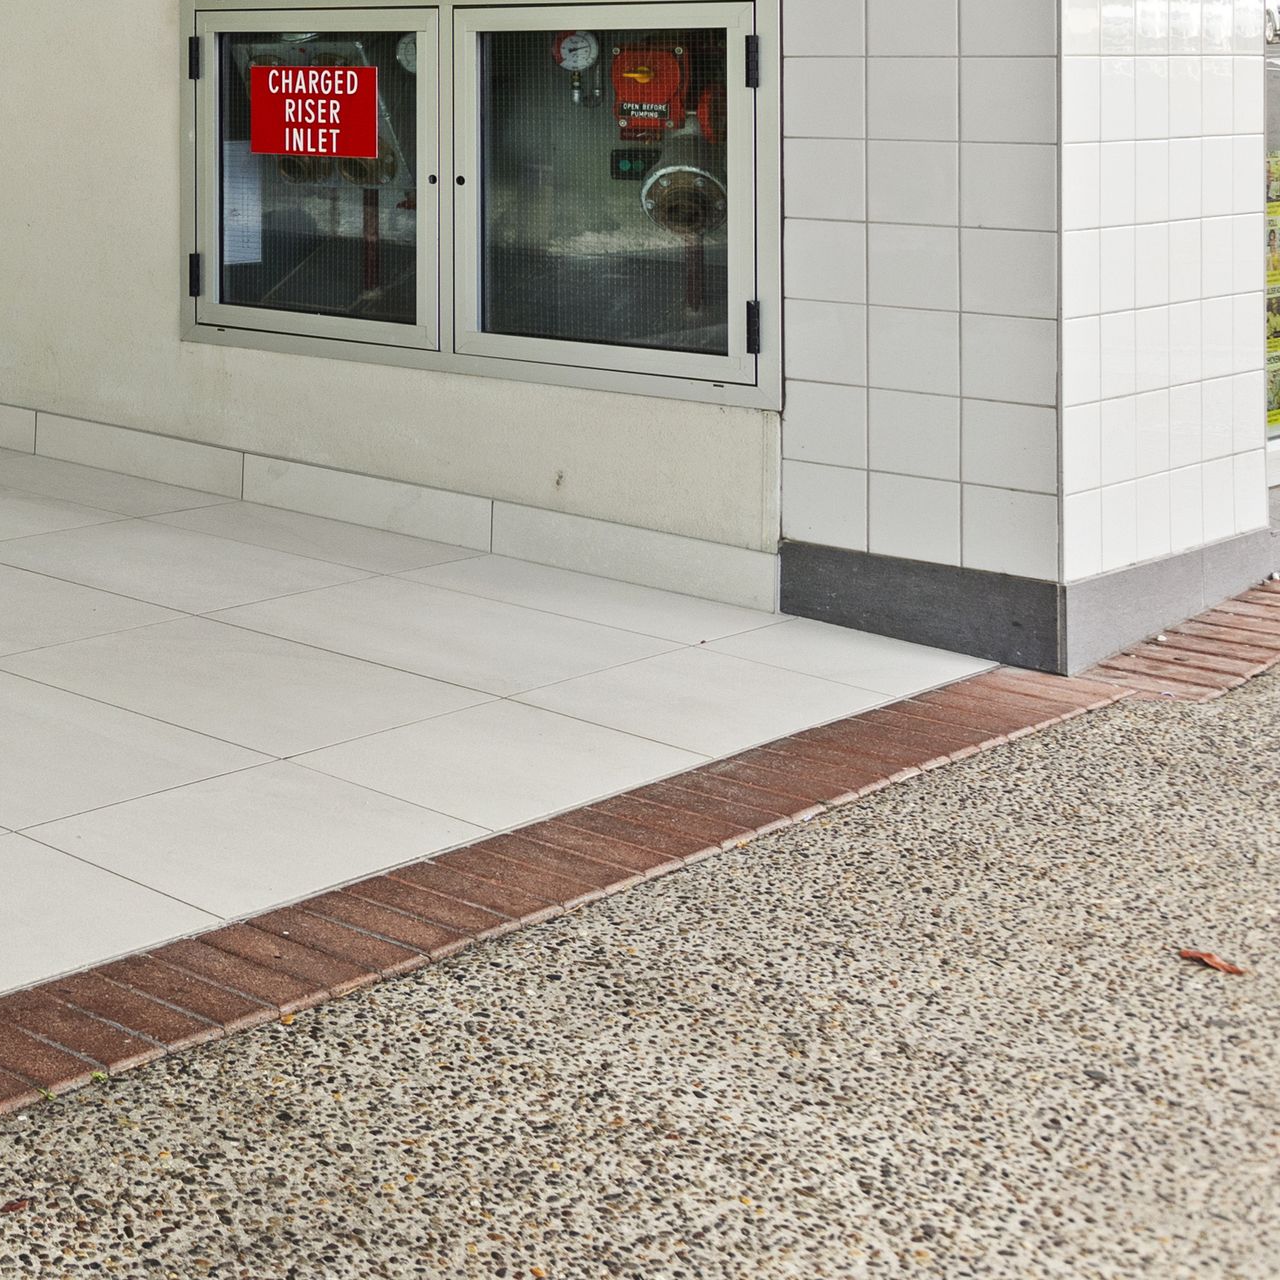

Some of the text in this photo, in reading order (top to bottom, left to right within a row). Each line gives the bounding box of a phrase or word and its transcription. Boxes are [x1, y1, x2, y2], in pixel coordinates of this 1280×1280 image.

[268, 69, 358, 95] CHARGED
[285, 99, 340, 124] RISER
[642, 103, 667, 111] BEFORE
[285, 128, 340, 153] INLET
